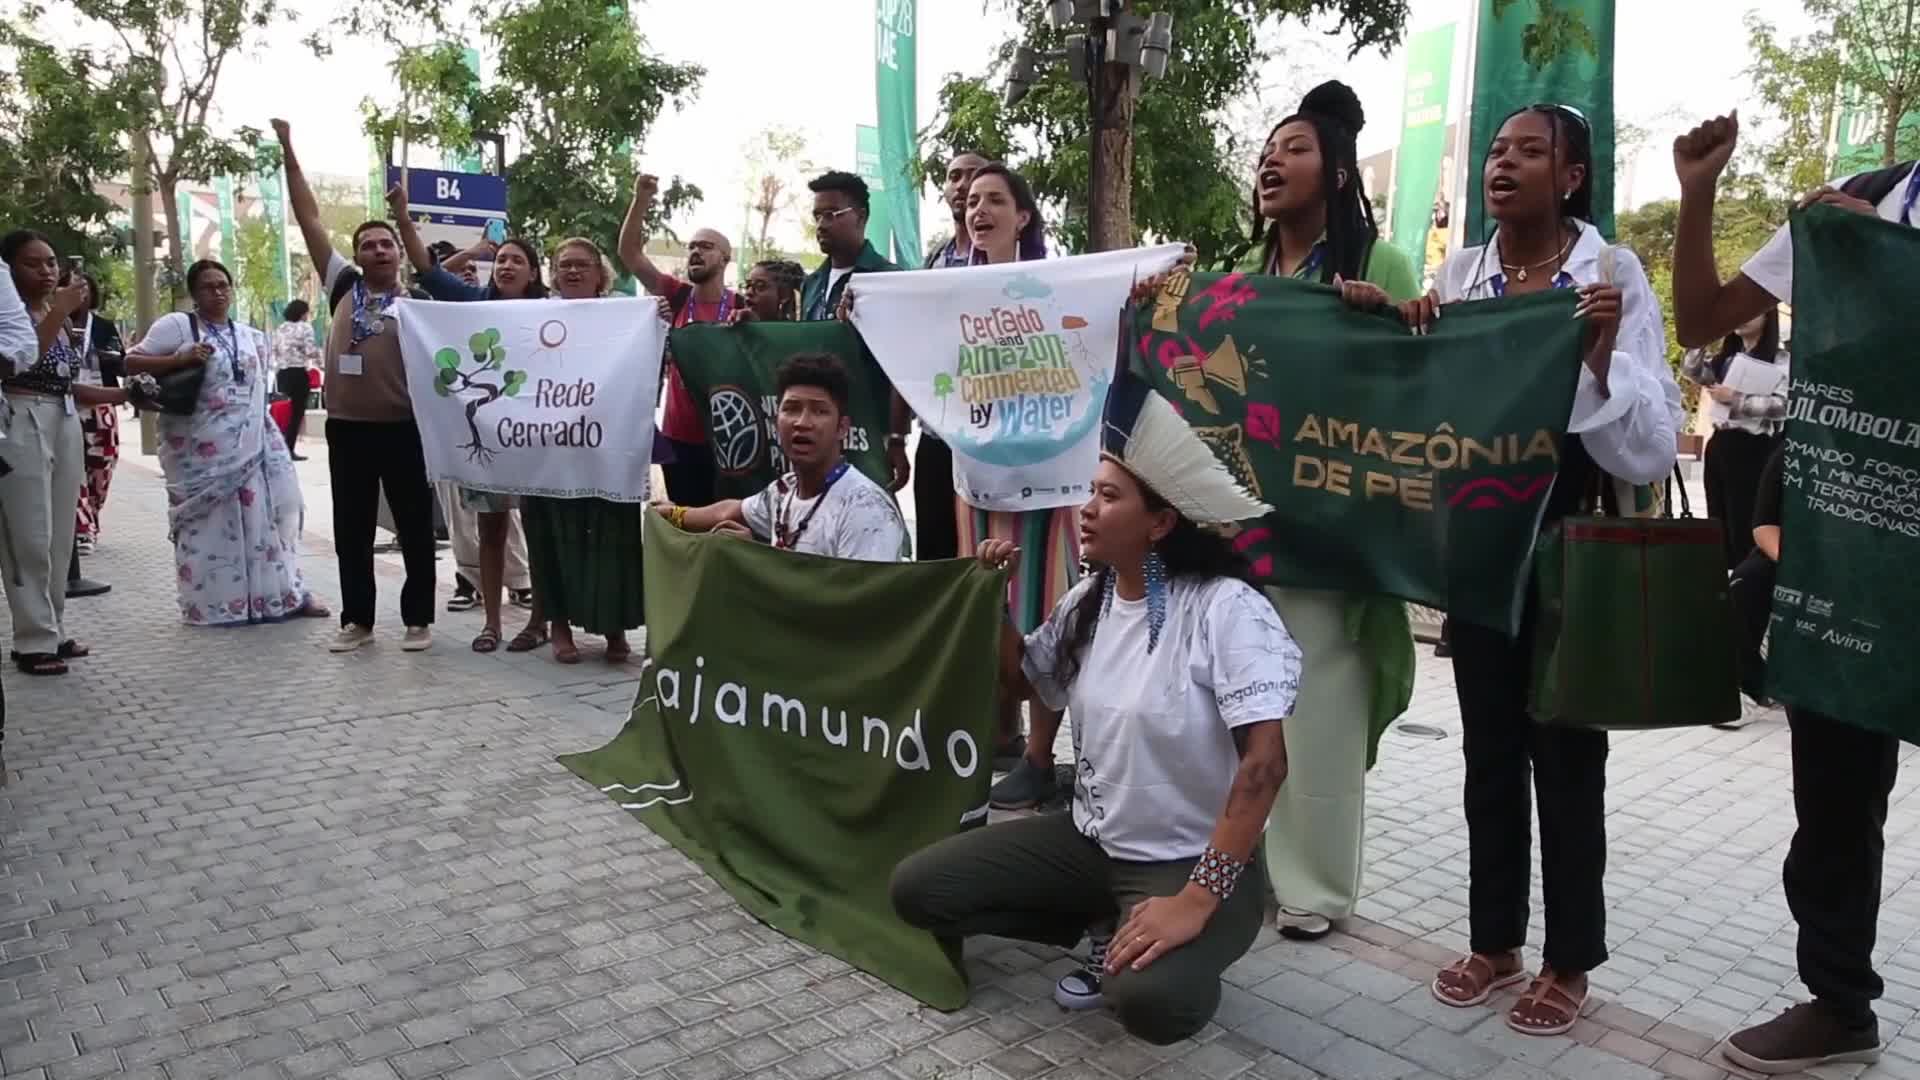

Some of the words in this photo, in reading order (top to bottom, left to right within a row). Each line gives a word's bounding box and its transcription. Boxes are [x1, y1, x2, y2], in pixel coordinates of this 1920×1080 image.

[436, 177, 461, 200] B4
[960, 304, 1044, 345] Cerrado
[999, 334, 1024, 347] and
[535, 377, 595, 409] Rede
[1788, 377, 1855, 404] HARES
[970, 403, 993, 428] by
[998, 393, 1074, 434] Water
[497, 414, 603, 448] Cerrado
[1294, 413, 1560, 470] AMAZÔNIA
[1293, 454, 1353, 497] DE
[1365, 471, 1434, 512] PÉ
[1808, 463, 1820, 476] A
[1807, 495, 1920, 537] TRADICIONAIS
[1821, 629, 1873, 653] Avina
